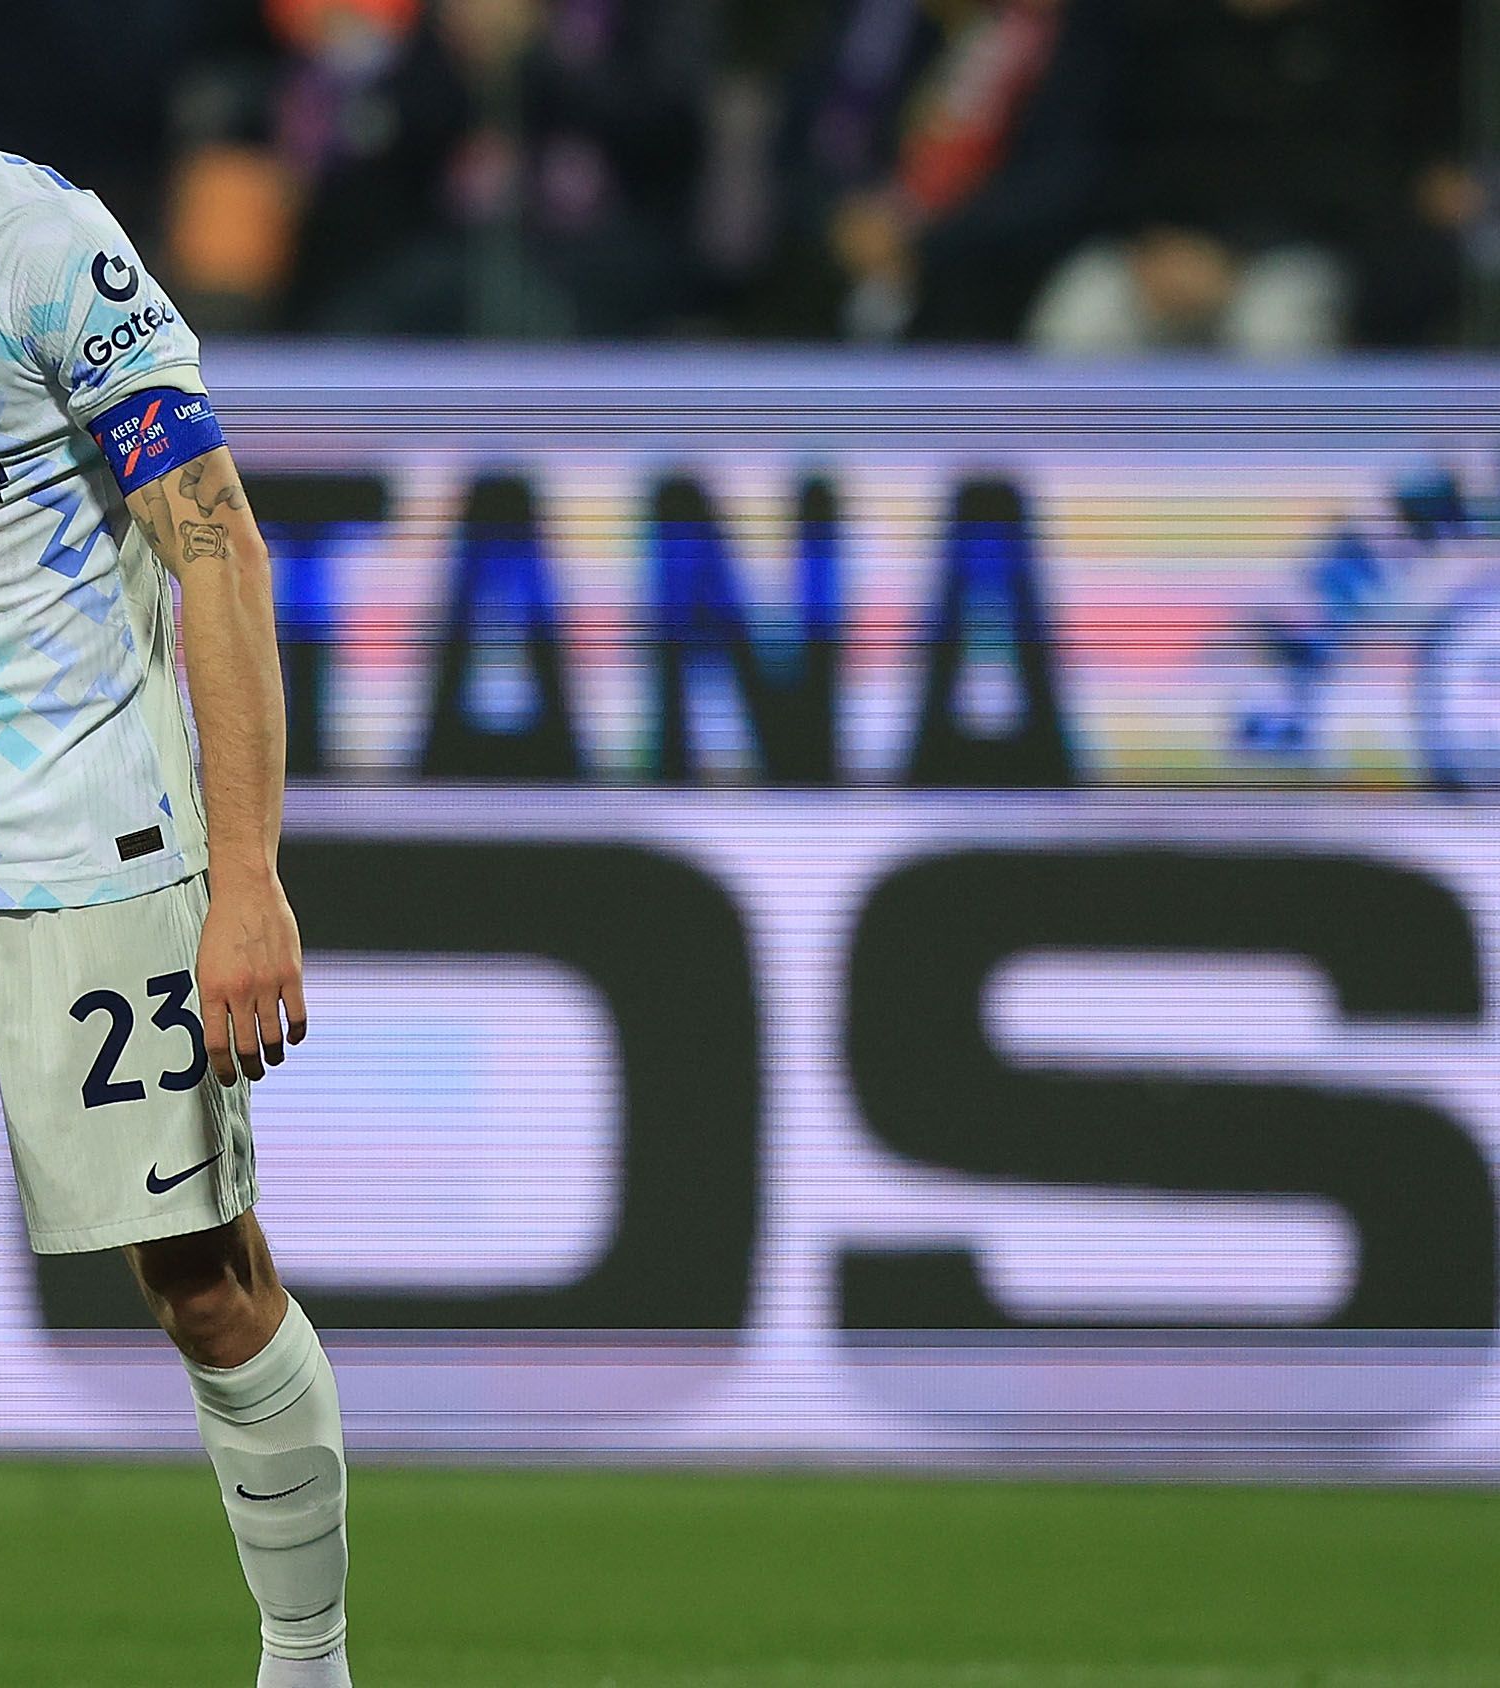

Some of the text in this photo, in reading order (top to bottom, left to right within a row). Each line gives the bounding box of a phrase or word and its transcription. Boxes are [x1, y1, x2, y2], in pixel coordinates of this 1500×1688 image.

[174, 401, 202, 420] Unar
[110, 417, 140, 441] KEEP
[118, 422, 164, 456] RACISM
[146, 437, 170, 458] OUT
[69, 969, 208, 1109] 23
